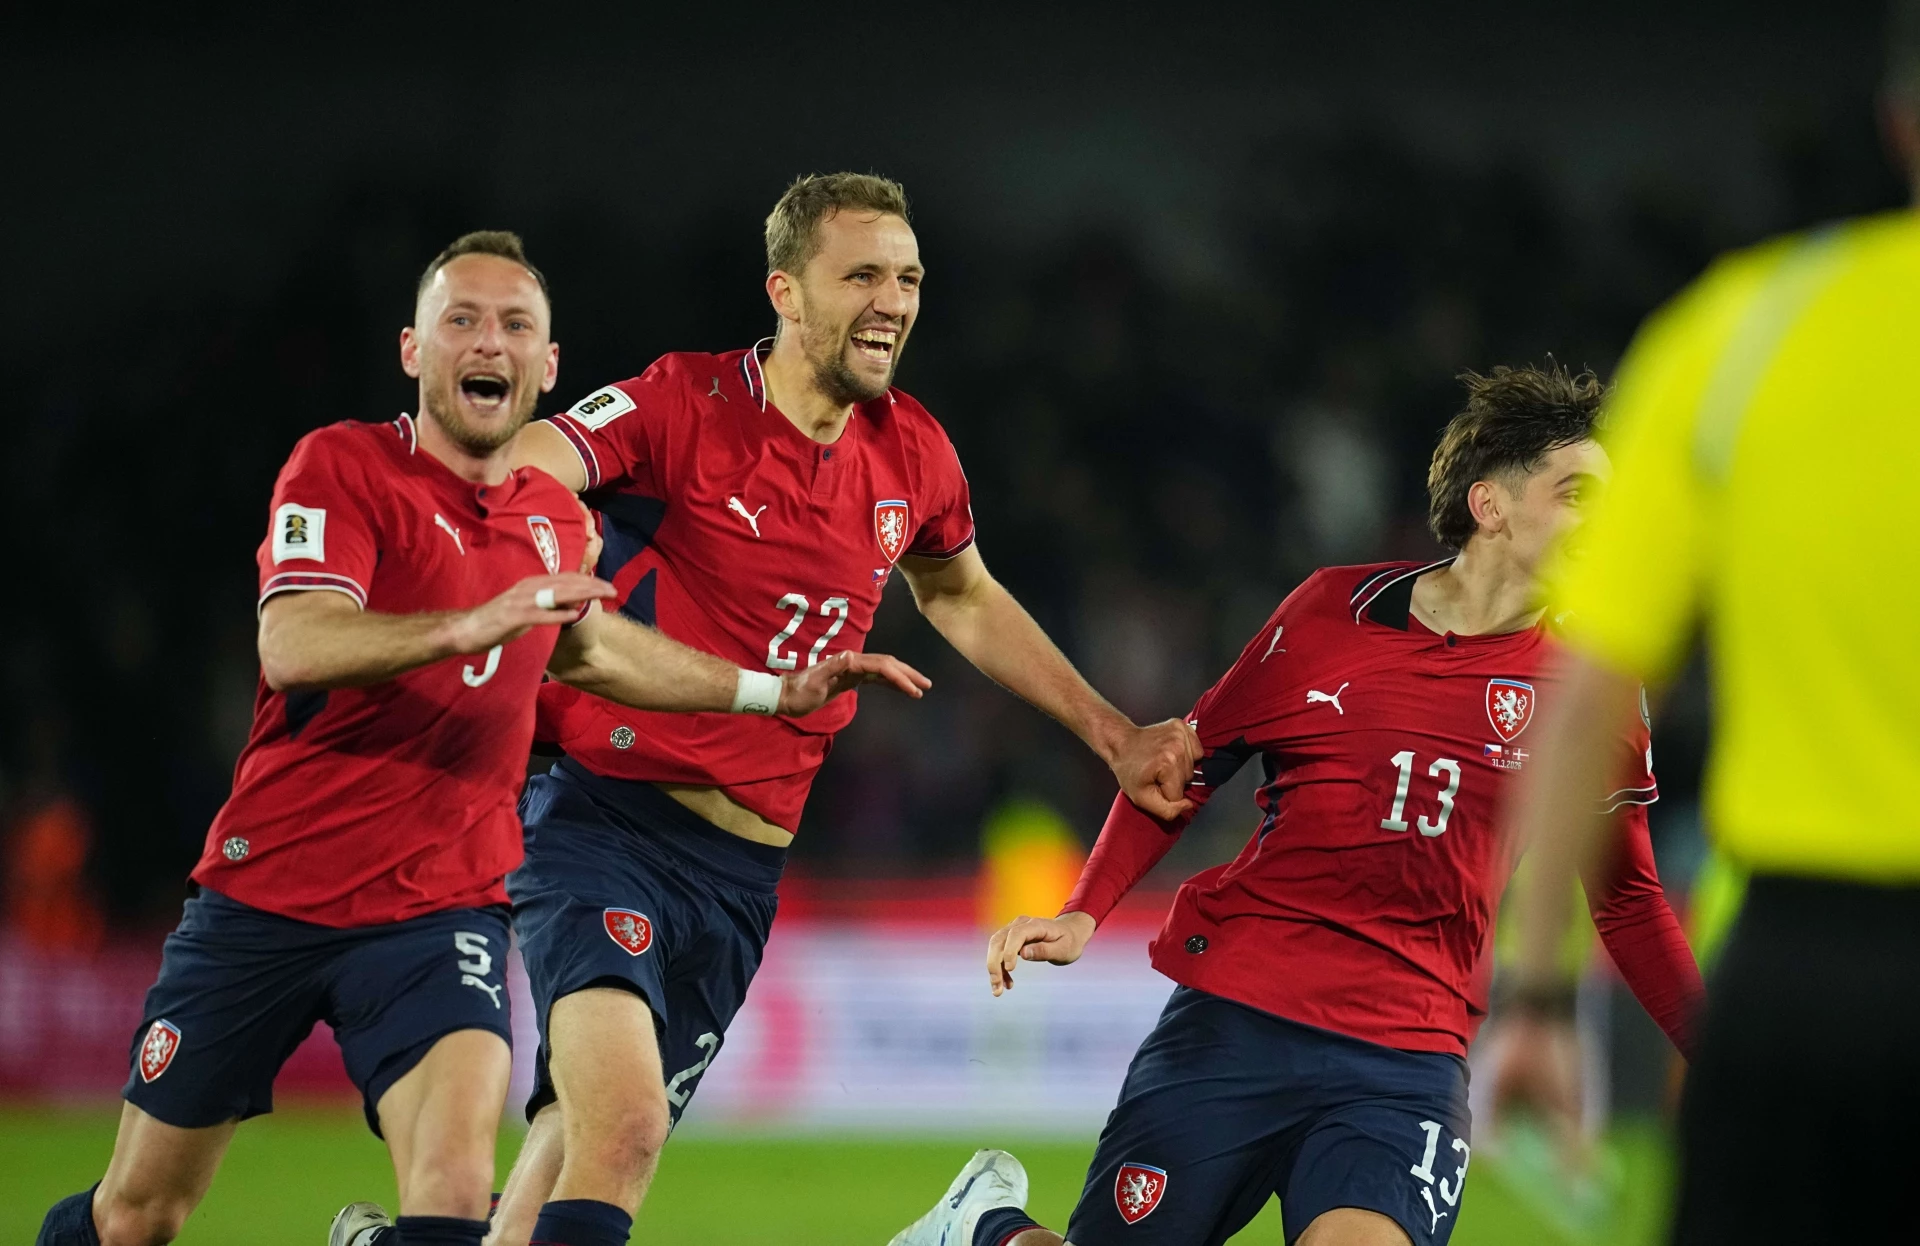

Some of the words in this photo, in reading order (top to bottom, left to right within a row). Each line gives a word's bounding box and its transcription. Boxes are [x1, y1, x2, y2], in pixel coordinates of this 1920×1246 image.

[766, 593, 849, 670] 22
[1381, 751, 1461, 837] 13
[454, 931, 492, 976] 5
[1410, 1120, 1471, 1206] 13
